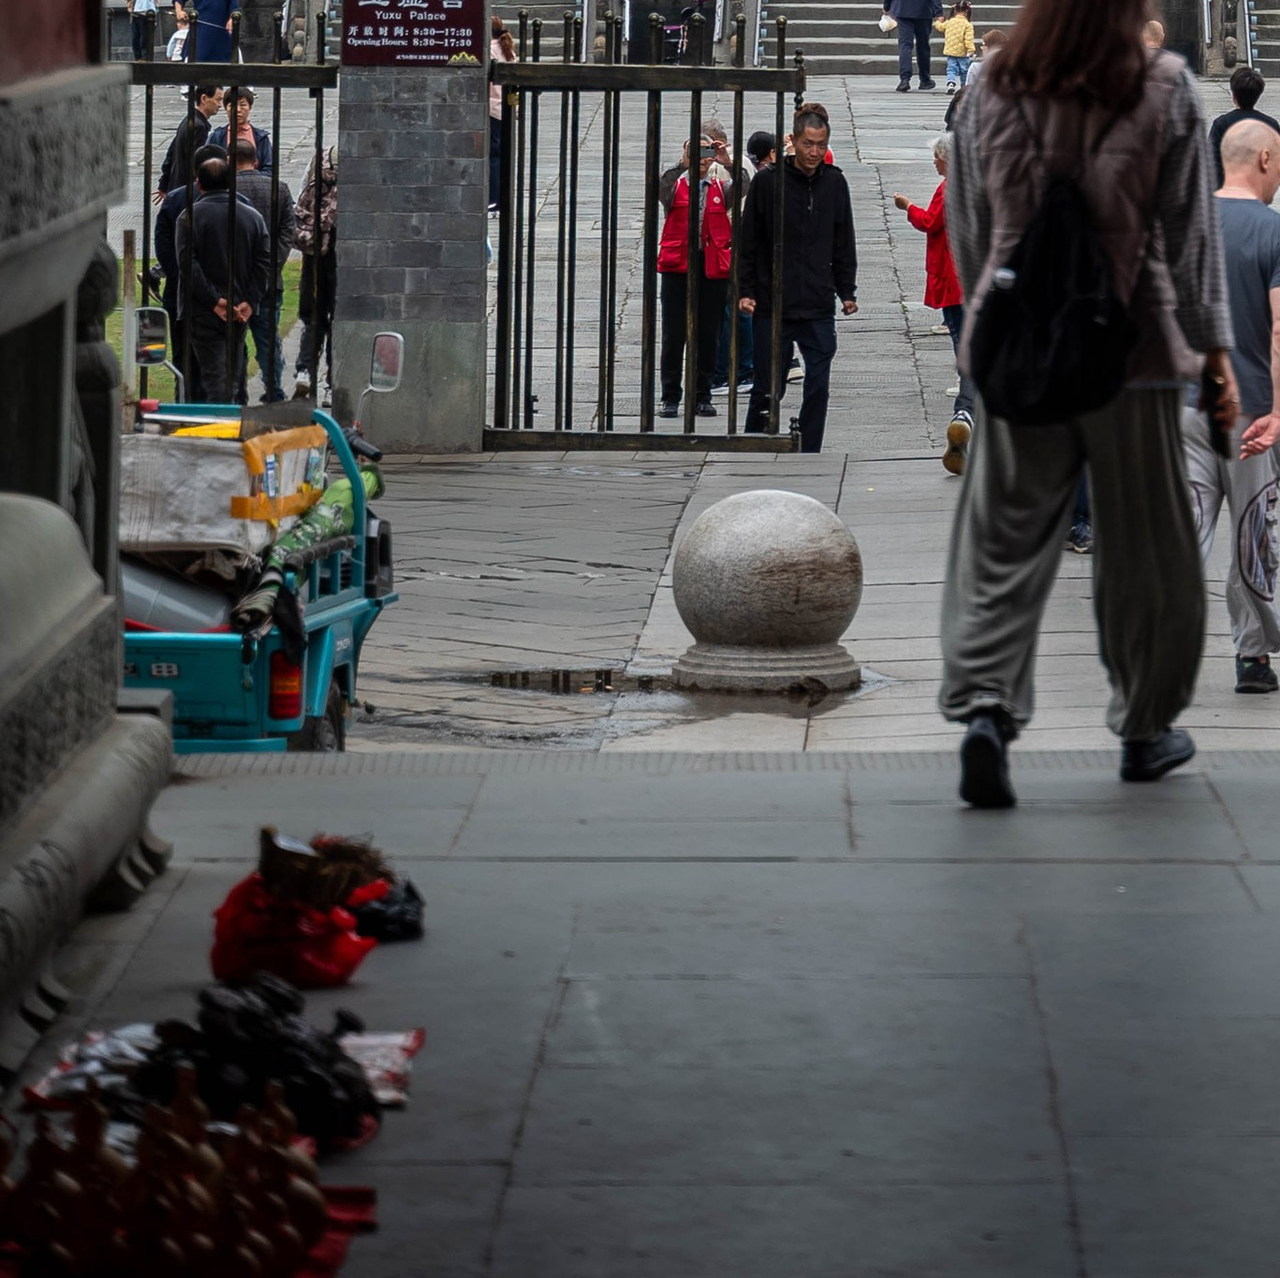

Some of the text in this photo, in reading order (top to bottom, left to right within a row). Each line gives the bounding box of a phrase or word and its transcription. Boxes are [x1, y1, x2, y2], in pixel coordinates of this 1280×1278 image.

[375, 11, 447, 20] Yuxu Palace
[347, 38, 381, 47] Opening
[381, 38, 408, 46] Hours:
